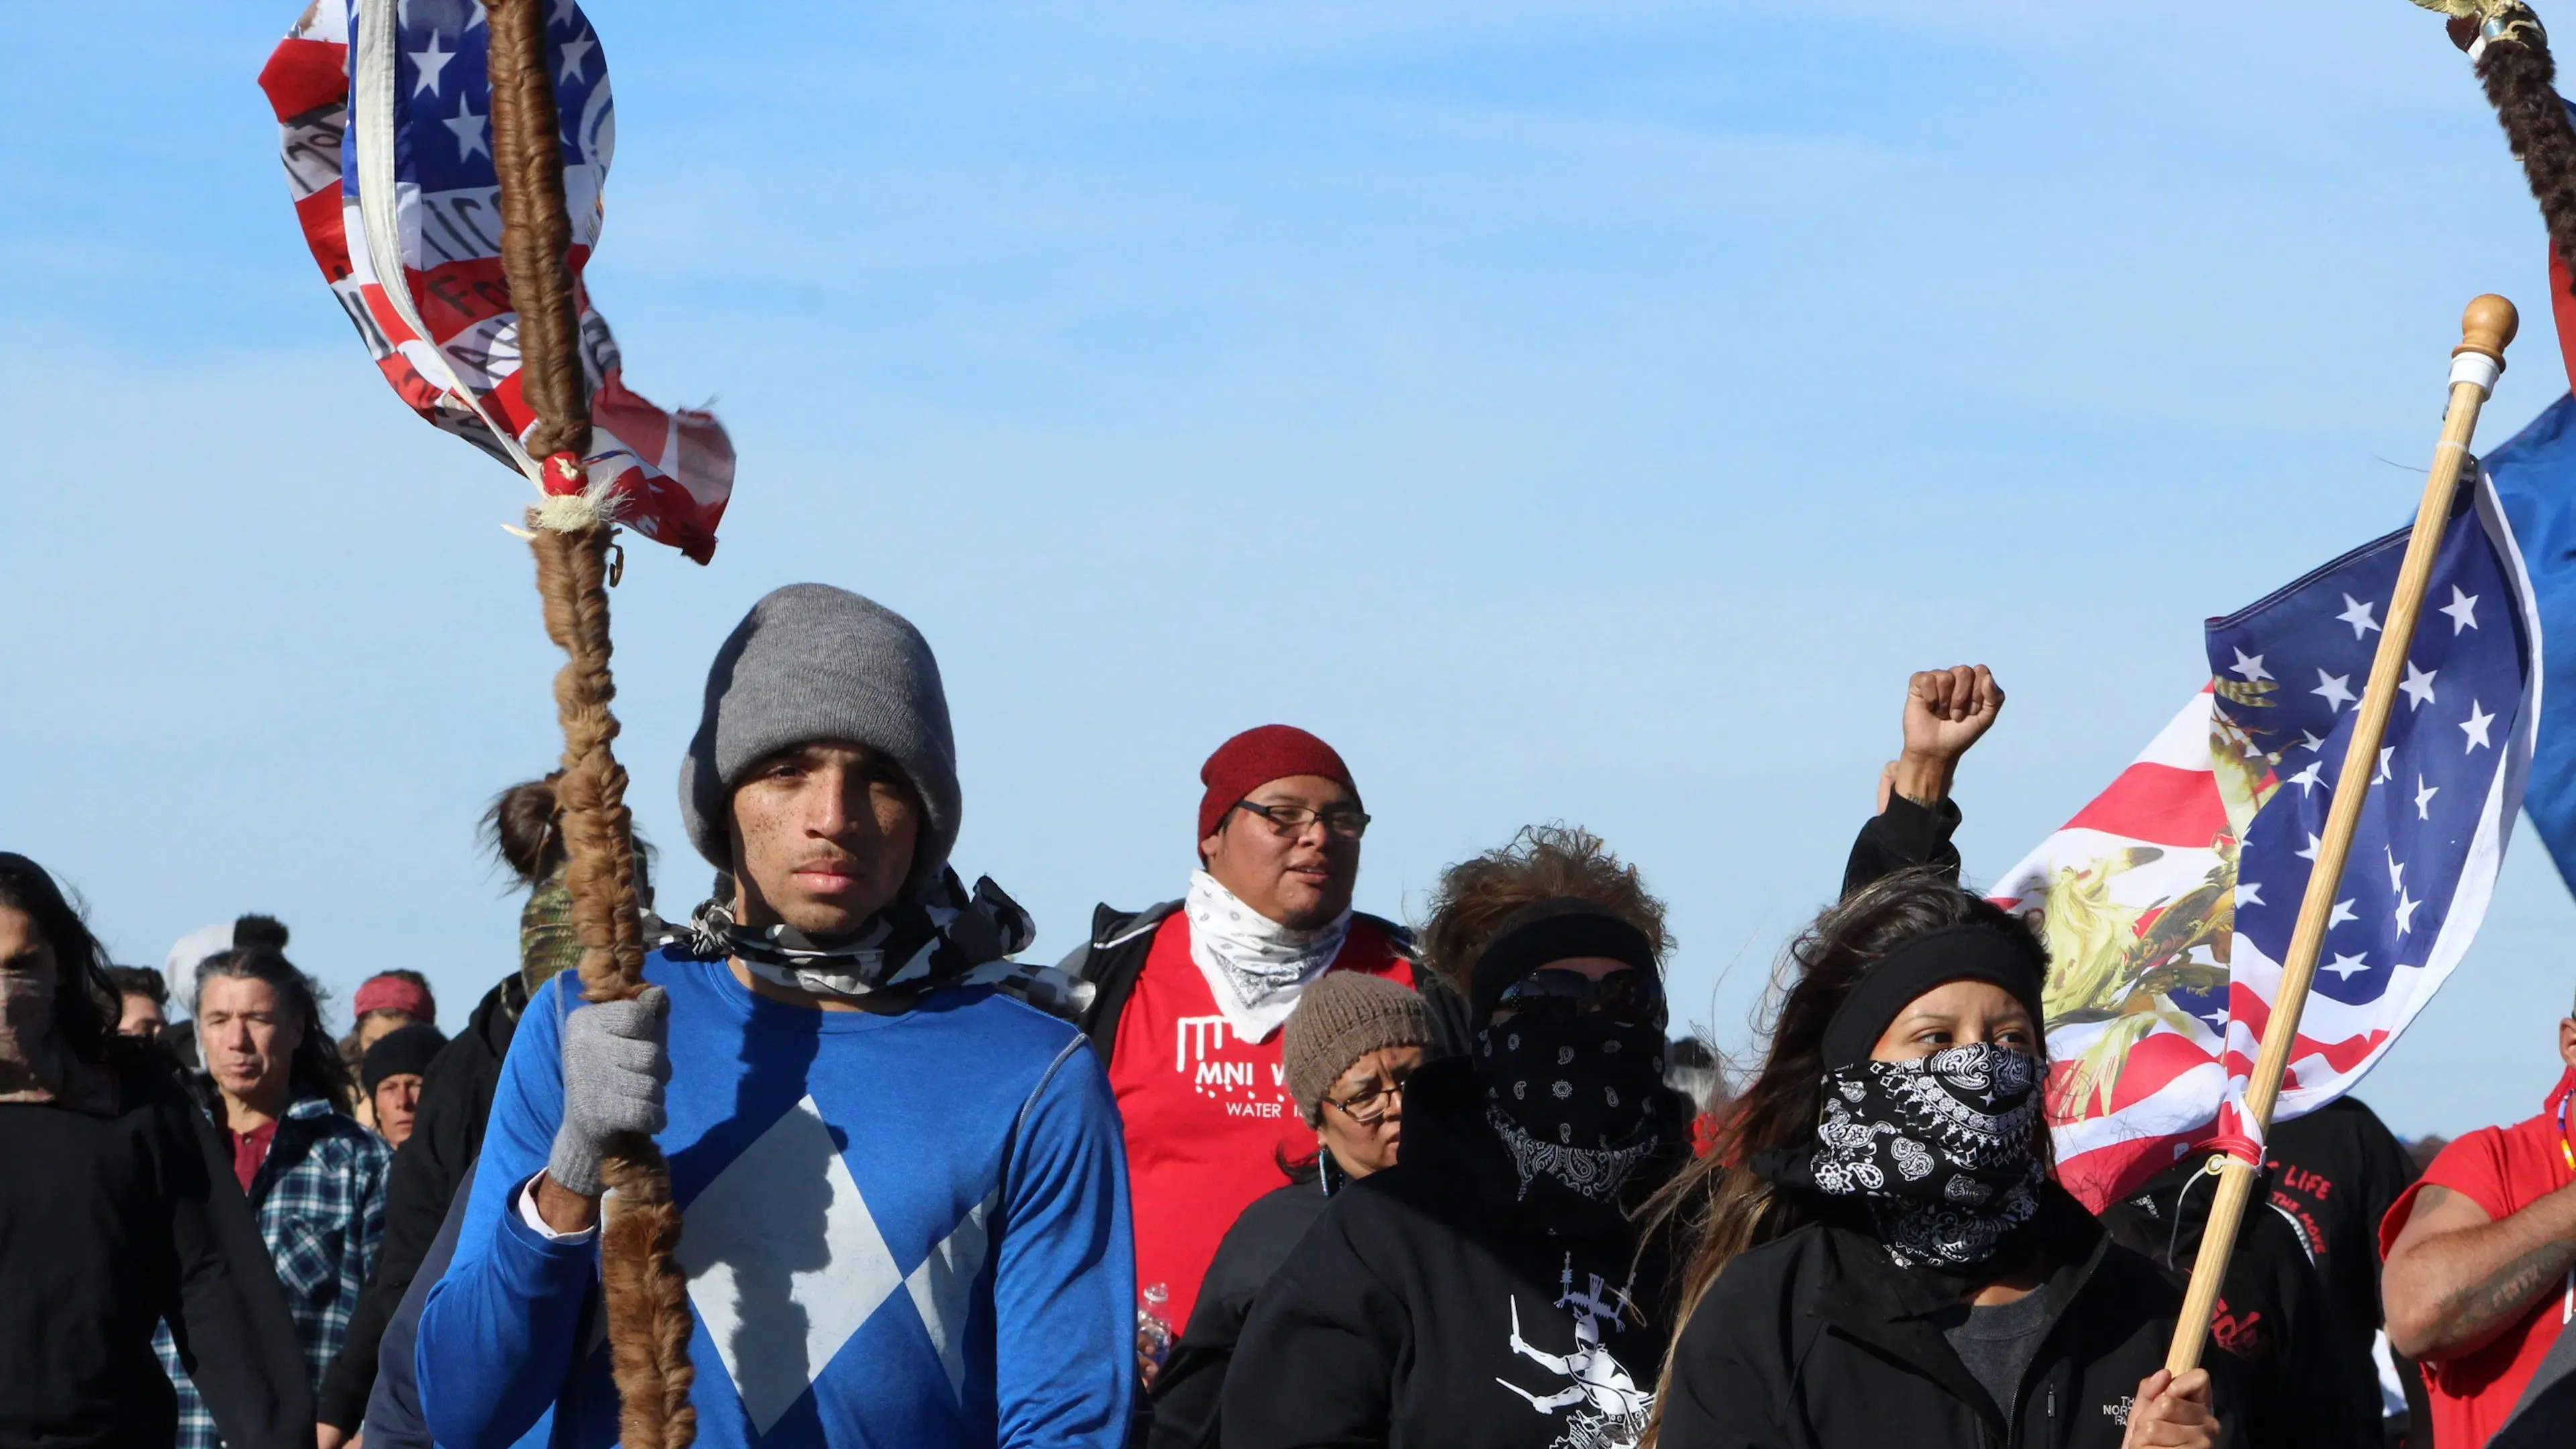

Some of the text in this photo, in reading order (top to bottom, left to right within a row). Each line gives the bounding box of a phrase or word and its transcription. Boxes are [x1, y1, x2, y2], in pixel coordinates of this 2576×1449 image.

[1195, 1061, 1253, 1086] MNI
[1226, 1102, 1281, 1118] WATER
[2284, 1165, 2332, 1200] LIFE
[2271, 1191, 2302, 1213] THE
[2102, 1404, 2131, 1416] NOR
[2121, 1395, 2135, 1406] TH
